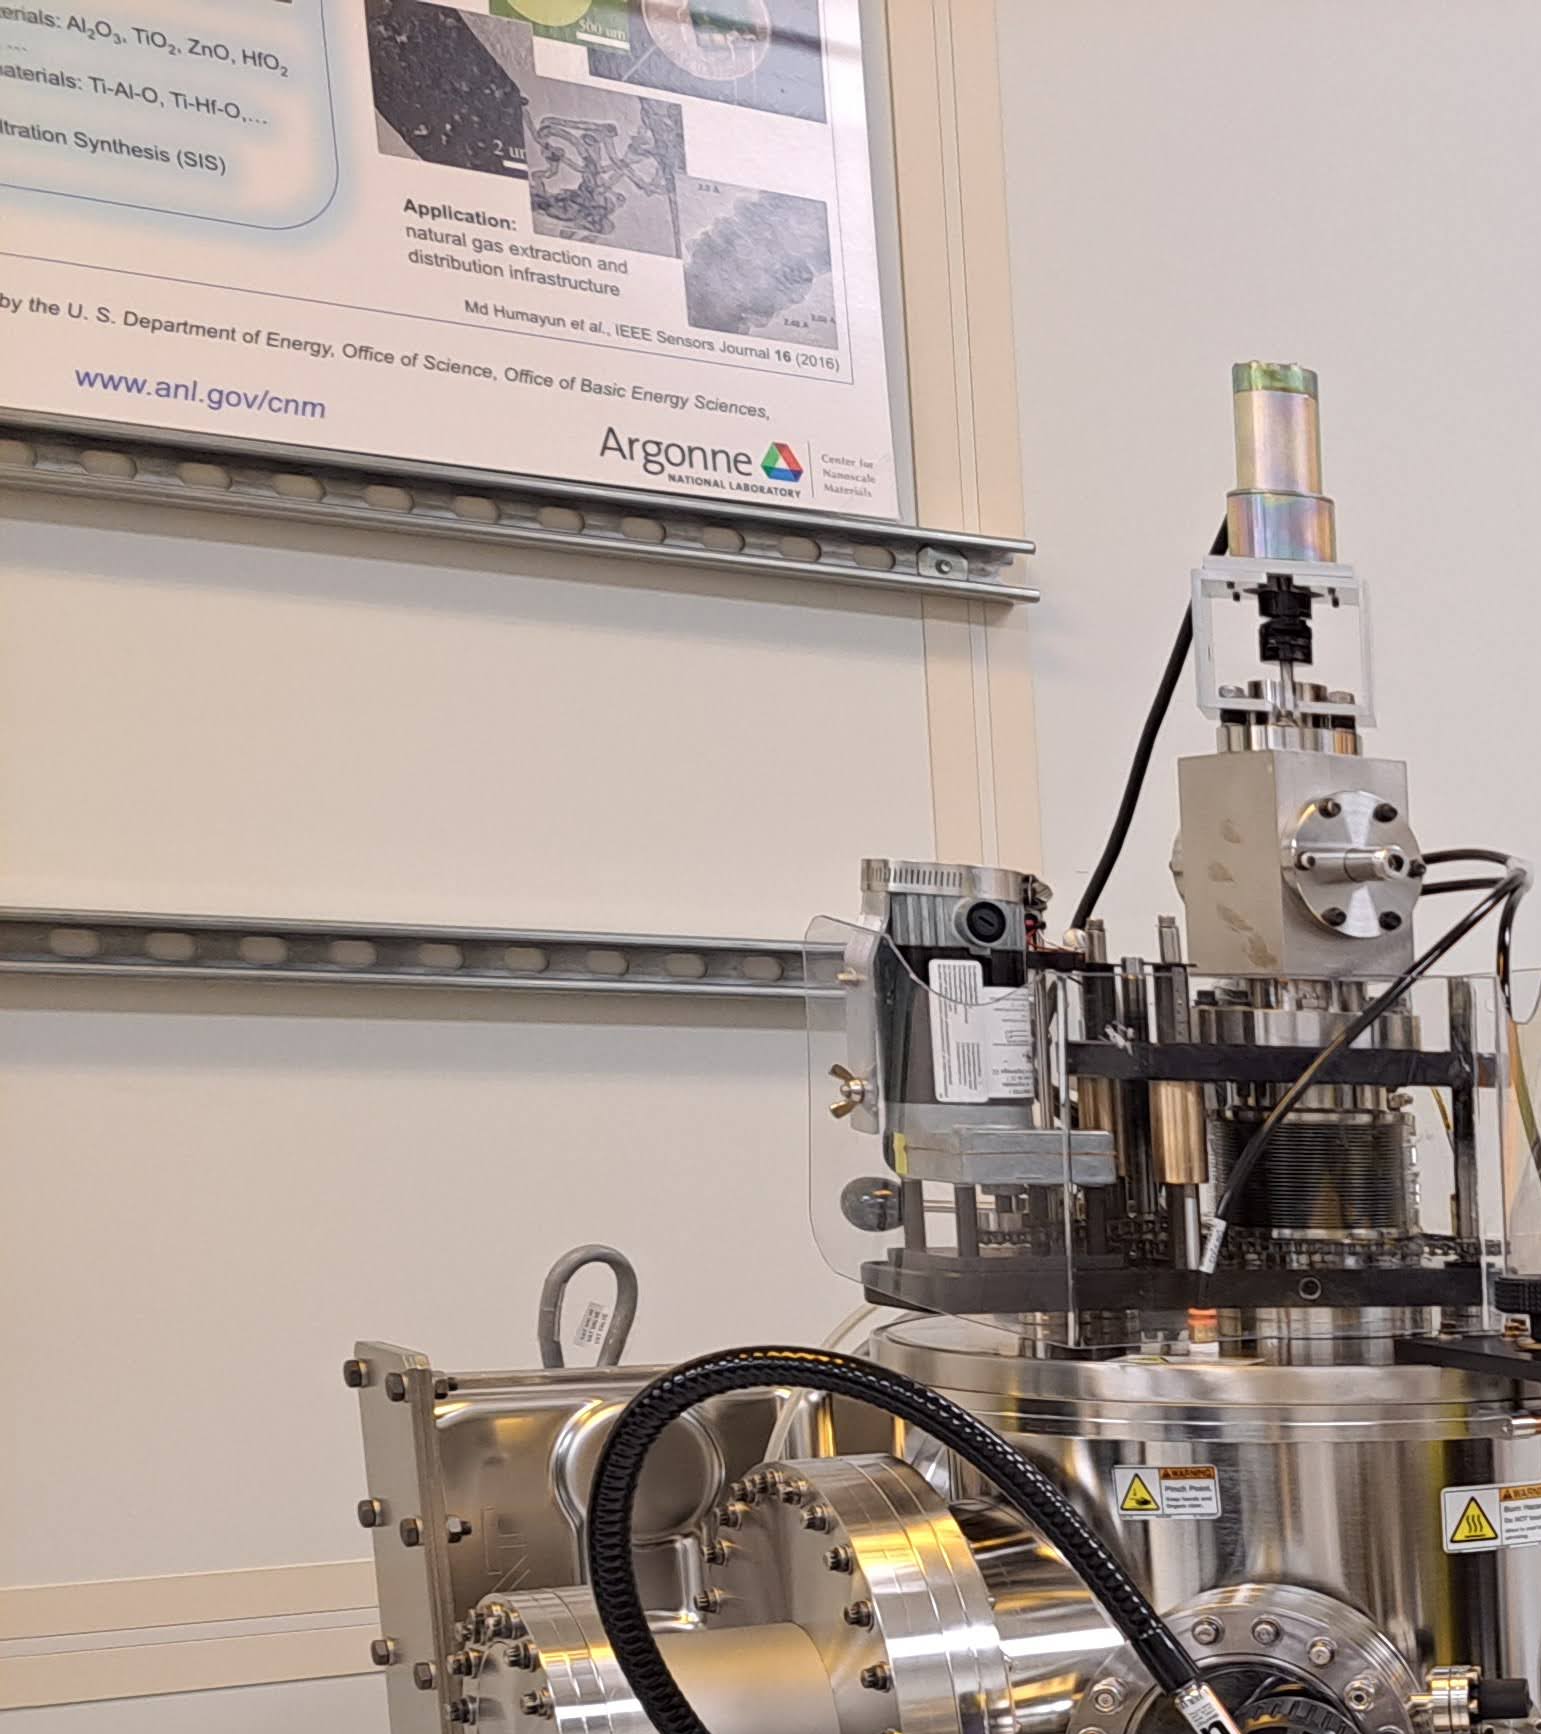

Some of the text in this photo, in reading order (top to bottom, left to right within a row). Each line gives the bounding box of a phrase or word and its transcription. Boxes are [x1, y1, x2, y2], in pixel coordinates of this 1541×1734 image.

[187, 38, 236, 64] ZnO,
[0, 64, 82, 91] aterials:
[88, 76, 164, 108] Ti-Al-O,
[74, 131, 170, 163] Synthesis
[177, 149, 226, 176] (SIS)
[404, 198, 517, 231] Application:
[406, 224, 629, 275] natural gas extraction and
[408, 249, 620, 297] distribution infrastructure
[0, 293, 770, 420] by the U. S. Department of Energy, Office of Science, Office of Basic Energy Sciences,
[465, 299, 489, 316] Md
[493, 303, 566, 333] Humayun
[571, 318, 586, 332] et
[615, 325, 652, 343] IEEE
[656, 329, 715, 352] Sensors
[719, 338, 771, 360] Journal
[774, 349, 791, 363] 16
[794, 351, 840, 373] (2016)
[74, 368, 327, 419] www.anl.gov/cnm
[600, 426, 752, 477] Argonne
[821, 453, 874, 469] Center for
[668, 473, 801, 499] NATIONAL LABORATORY
[822, 468, 876, 484] Nanoscale
[823, 483, 873, 498] Materials
